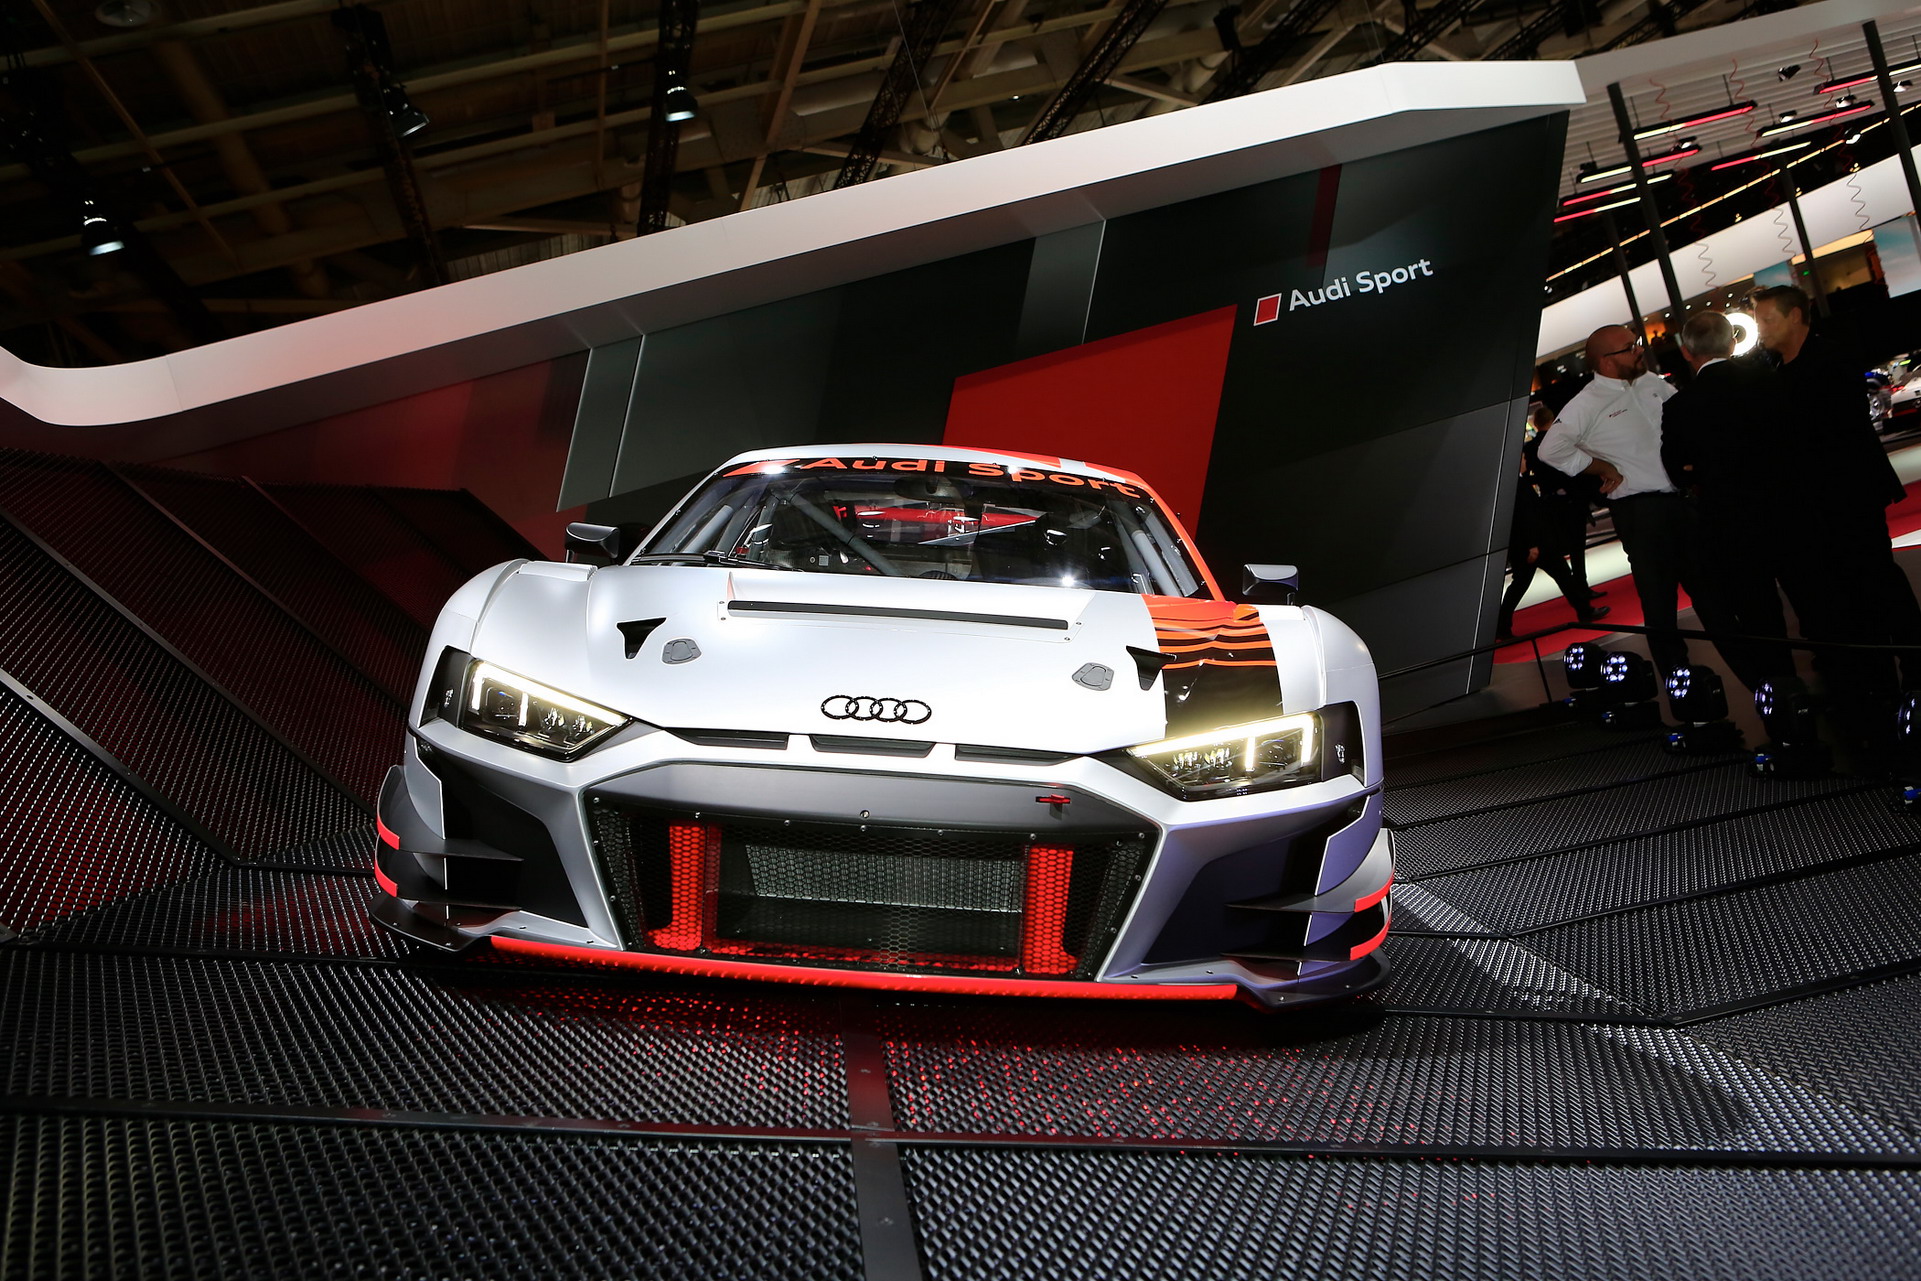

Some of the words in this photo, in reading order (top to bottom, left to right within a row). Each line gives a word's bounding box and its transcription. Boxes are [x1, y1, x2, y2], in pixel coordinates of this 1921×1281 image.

[1289, 277, 1351, 311] Audi
[1356, 259, 1433, 293] Sport
[800, 457, 946, 473] Audi
[968, 463, 1141, 499] Sport
